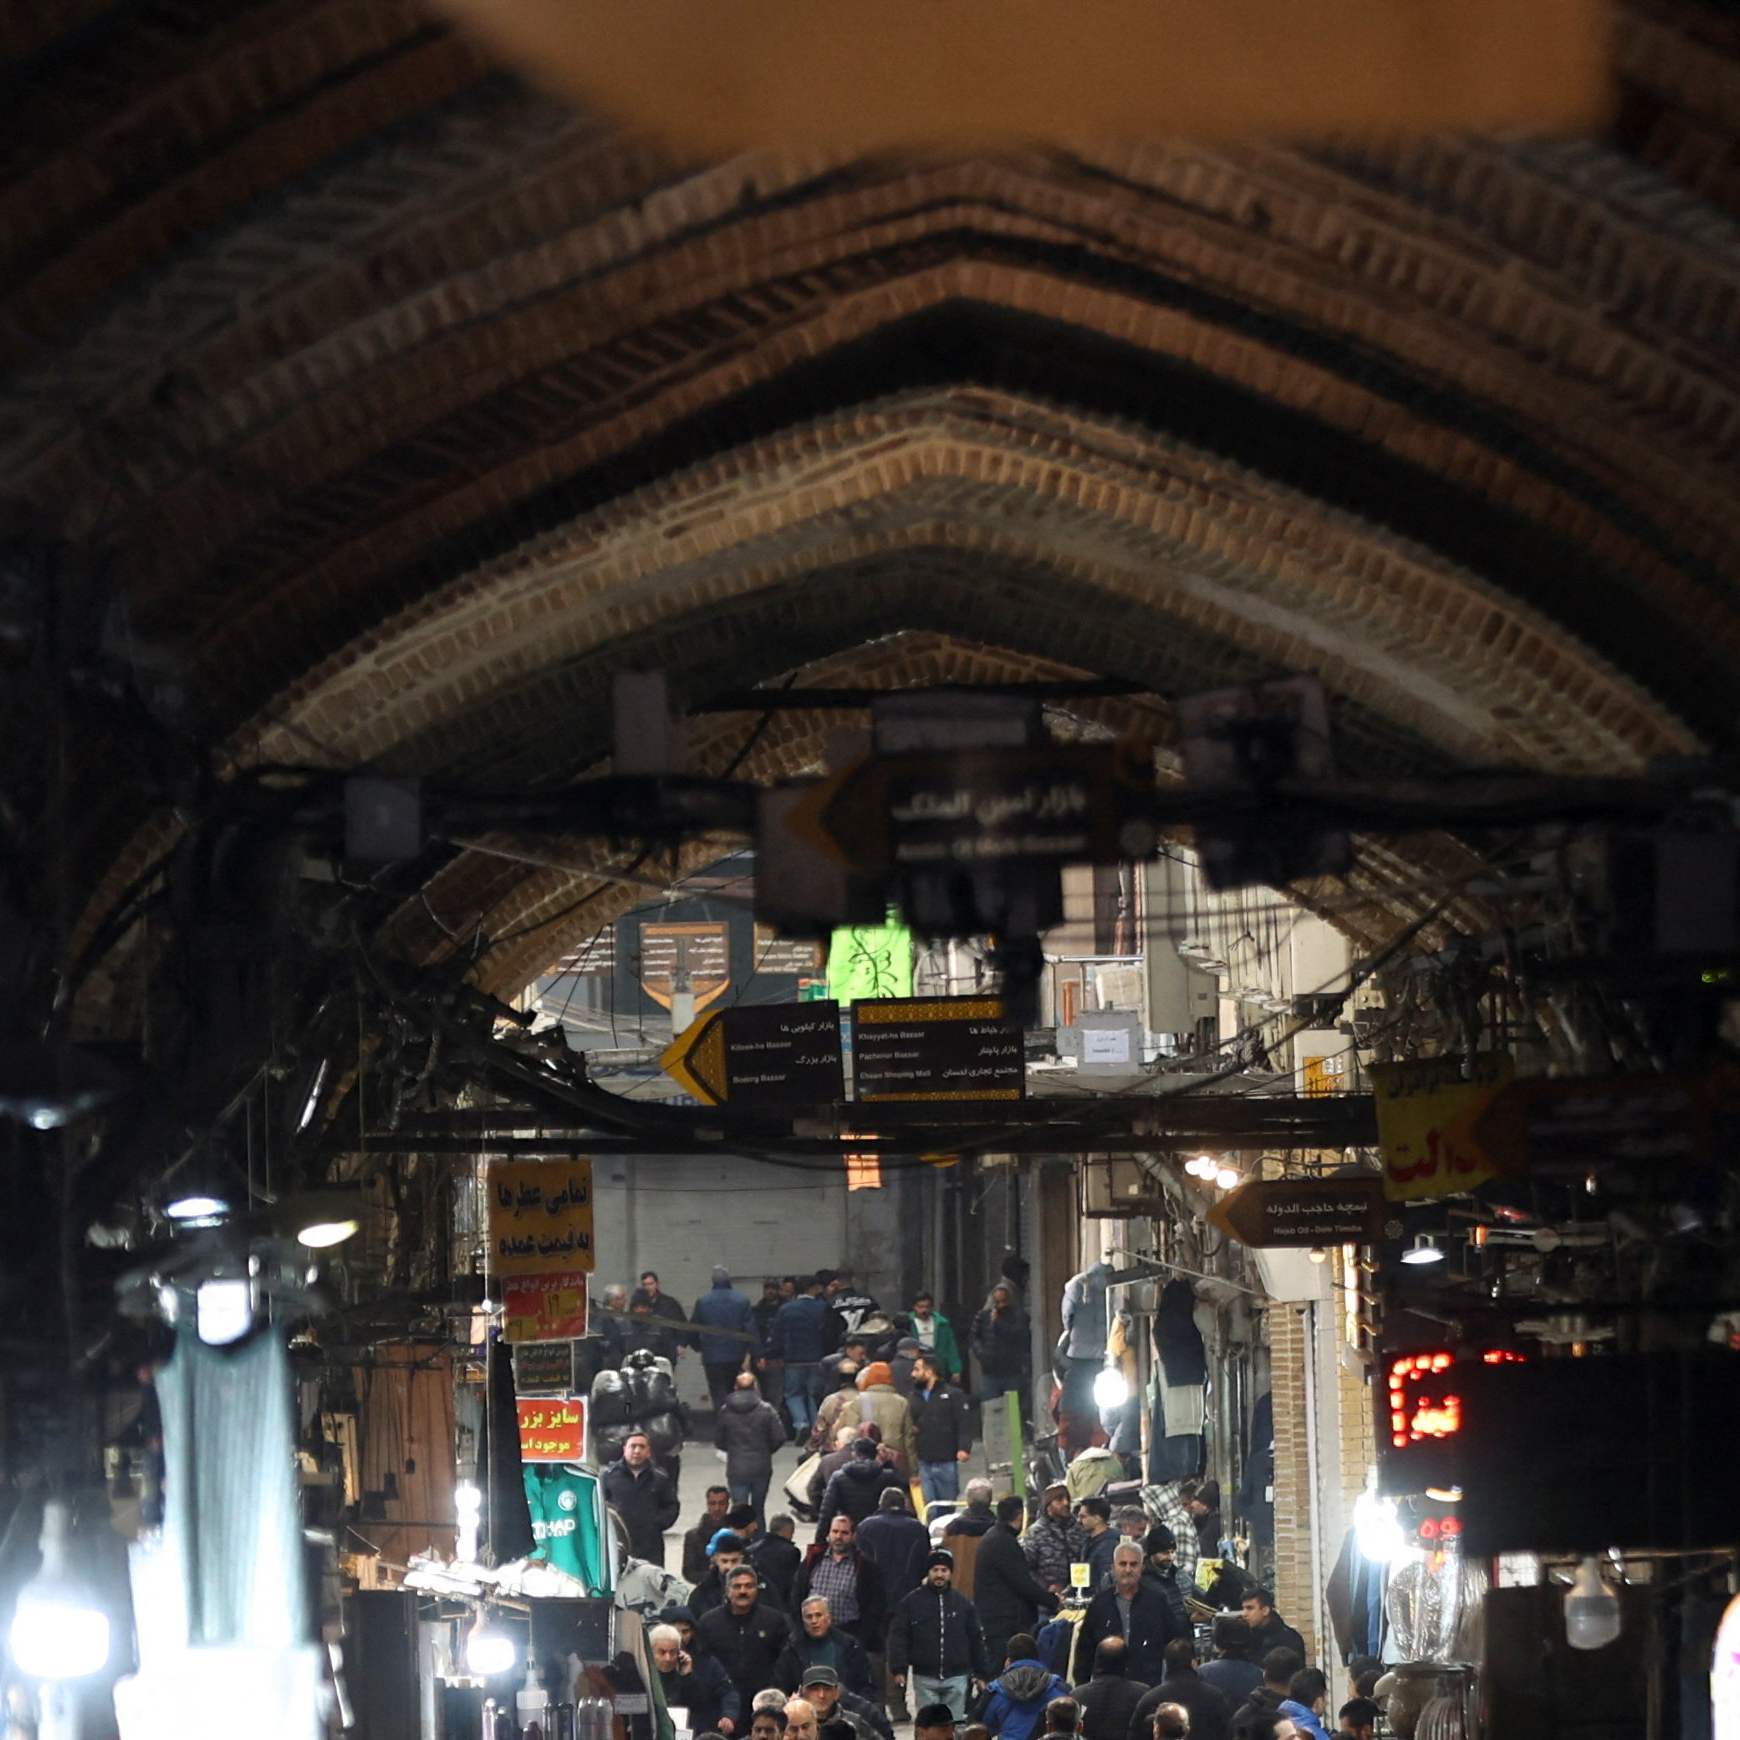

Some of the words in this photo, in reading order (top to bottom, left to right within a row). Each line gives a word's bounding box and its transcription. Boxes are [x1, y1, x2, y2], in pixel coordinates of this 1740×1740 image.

[1036, 785, 1087, 819] بازار
[779, 1023, 790, 1032] ها
[817, 1020, 835, 1032] بازار
[968, 1026, 979, 1035] ها
[980, 1025, 998, 1036] خیاط
[1000, 1044, 1018, 1056] بازار
[795, 1055, 819, 1066] بزرگ
[820, 1054, 837, 1064] بازار
[968, 1065, 993, 1078] تجاری
[994, 1066, 1019, 1079] مجتمع
[497, 1180, 541, 1218] عطرها
[545, 1177, 588, 1215] تمامی
[1266, 1202, 1300, 1217] الدوله
[1301, 1202, 1335, 1216] حاجب
[1336, 1201, 1368, 1216] تیمچه
[499, 1233, 536, 1257] عمده
[537, 1223, 575, 1260] قیمت
[576, 1231, 590, 1259] به
[517, 1407, 544, 1429] بزر
[546, 1407, 579, 1429] سایز
[520, 1437, 533, 1451] اس
[534, 1440, 571, 1454] موجود
[530, 1518, 576, 1538] TIHAD
